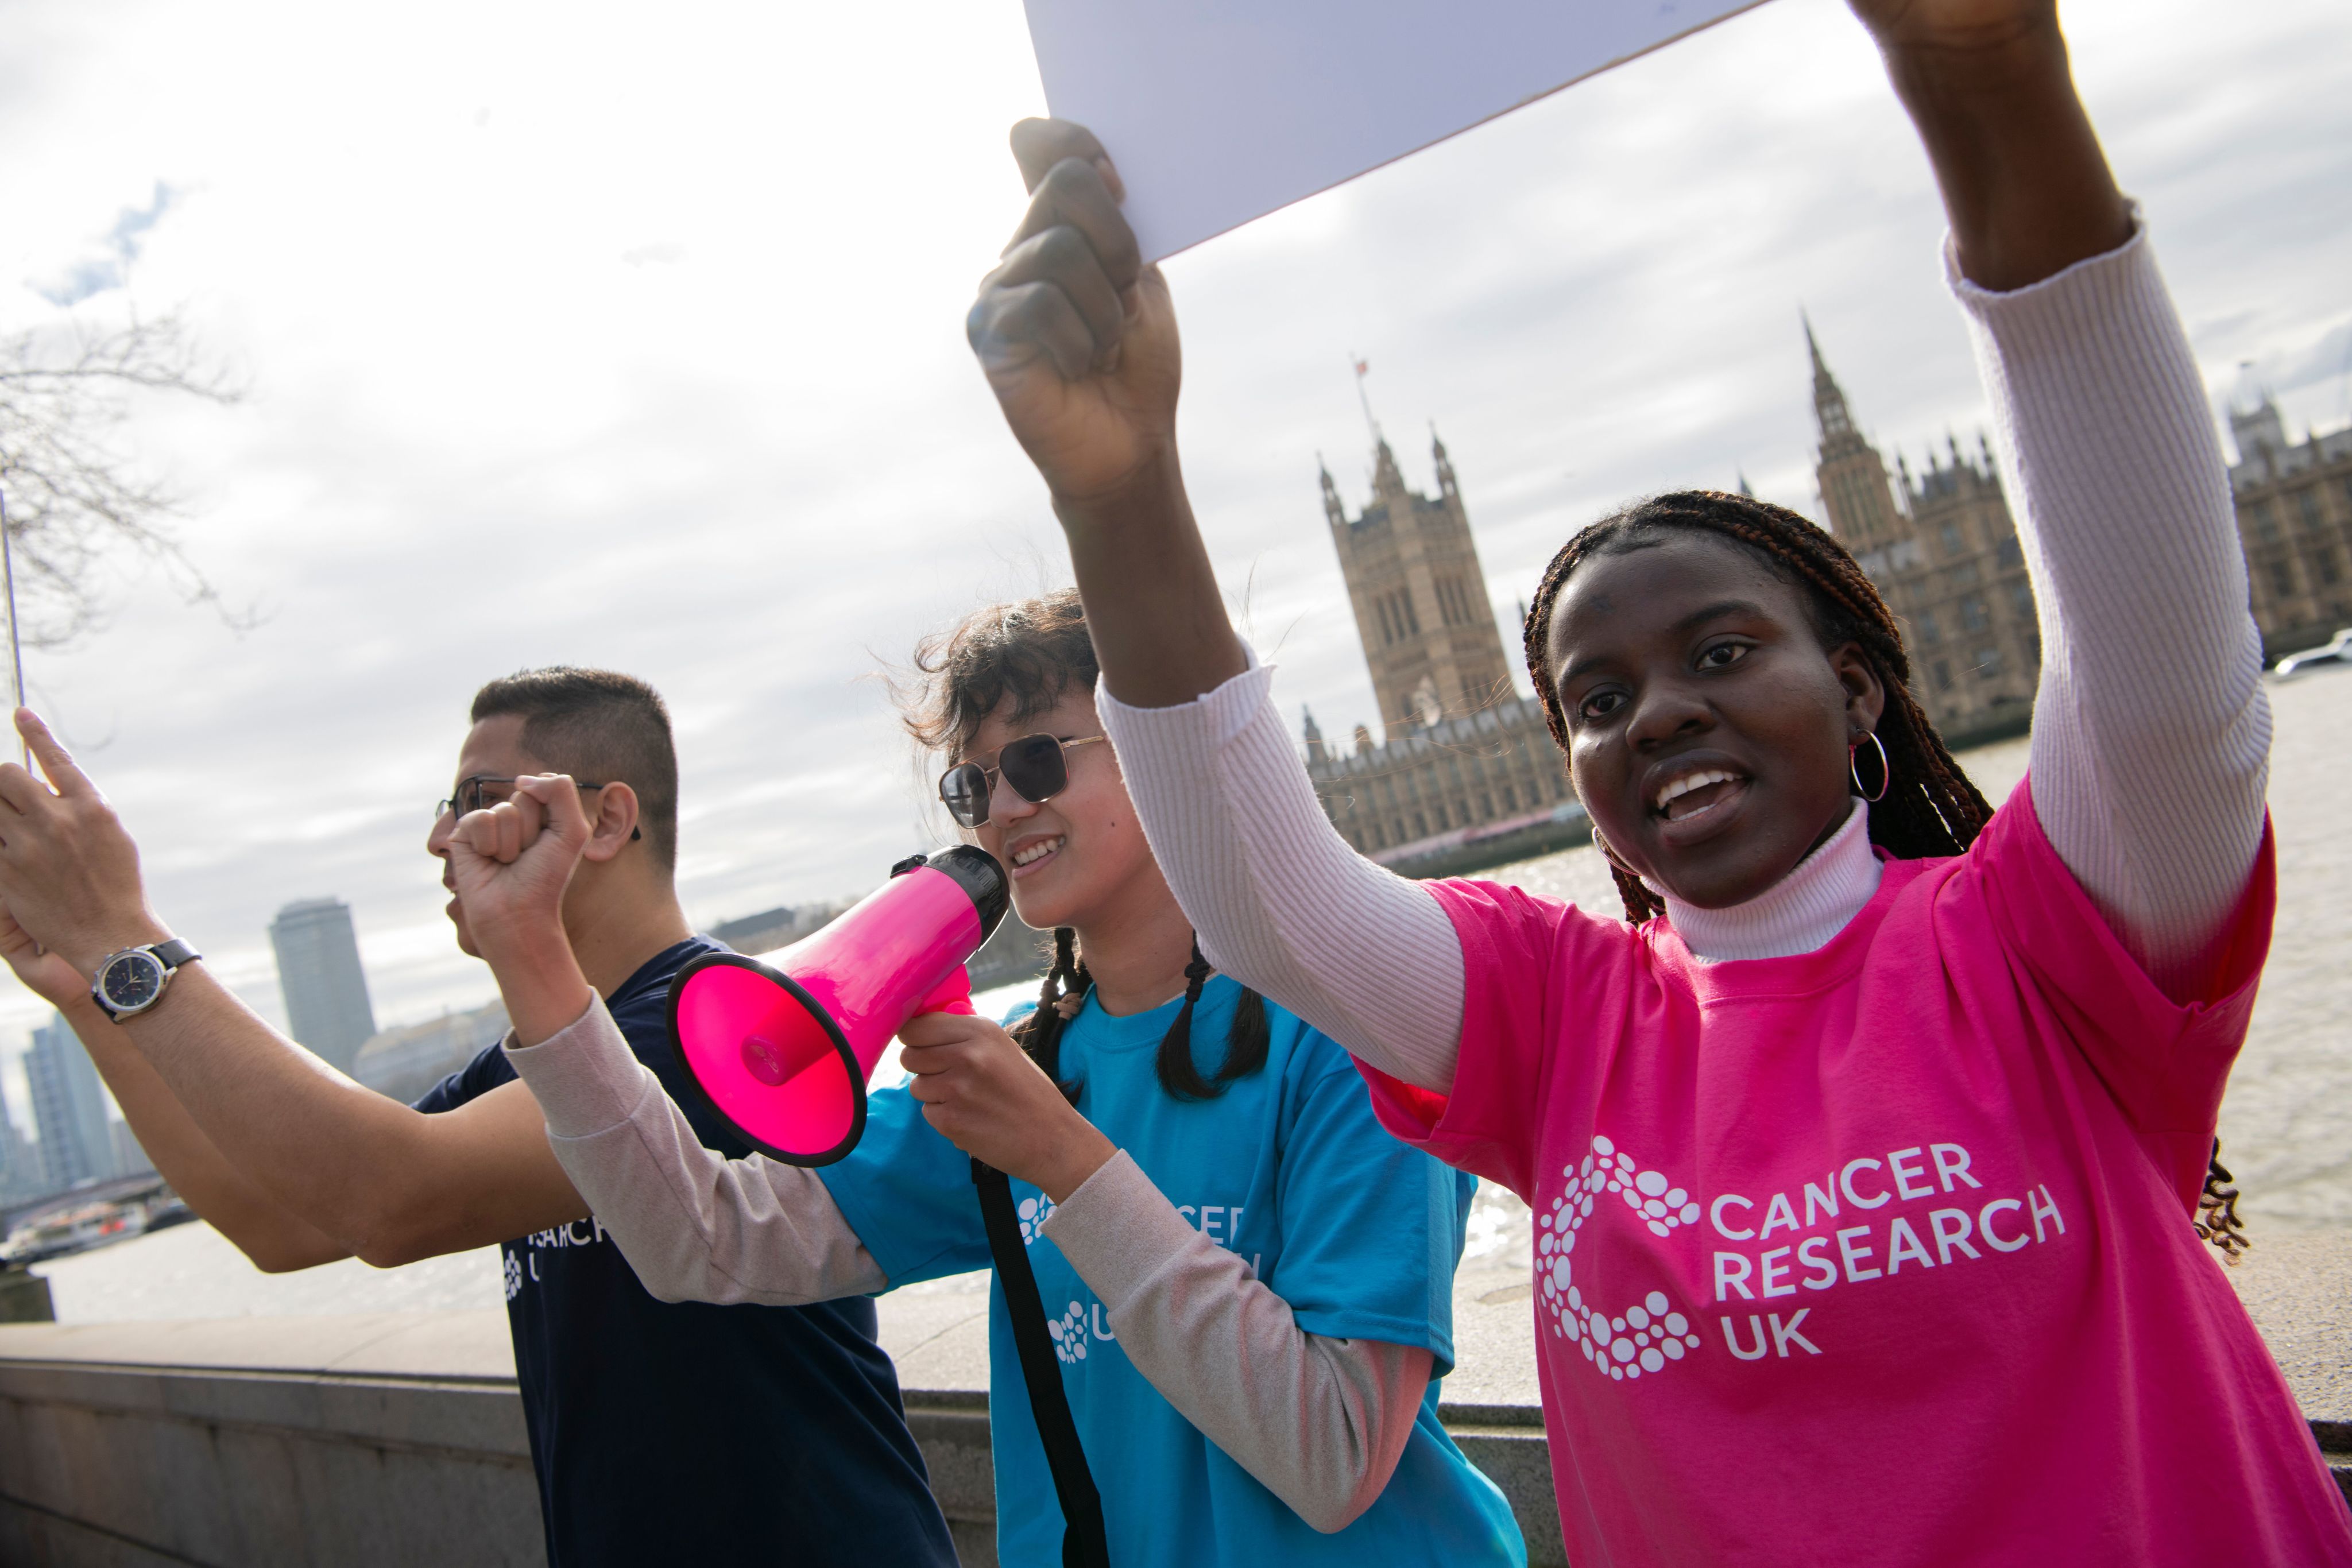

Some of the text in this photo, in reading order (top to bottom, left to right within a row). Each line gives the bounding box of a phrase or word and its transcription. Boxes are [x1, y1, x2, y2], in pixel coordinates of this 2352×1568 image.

[1710, 1143, 1982, 1241] CANCER
[1713, 1184, 2065, 1302] RESEARCH
[1720, 1308, 1823, 1360] UK
